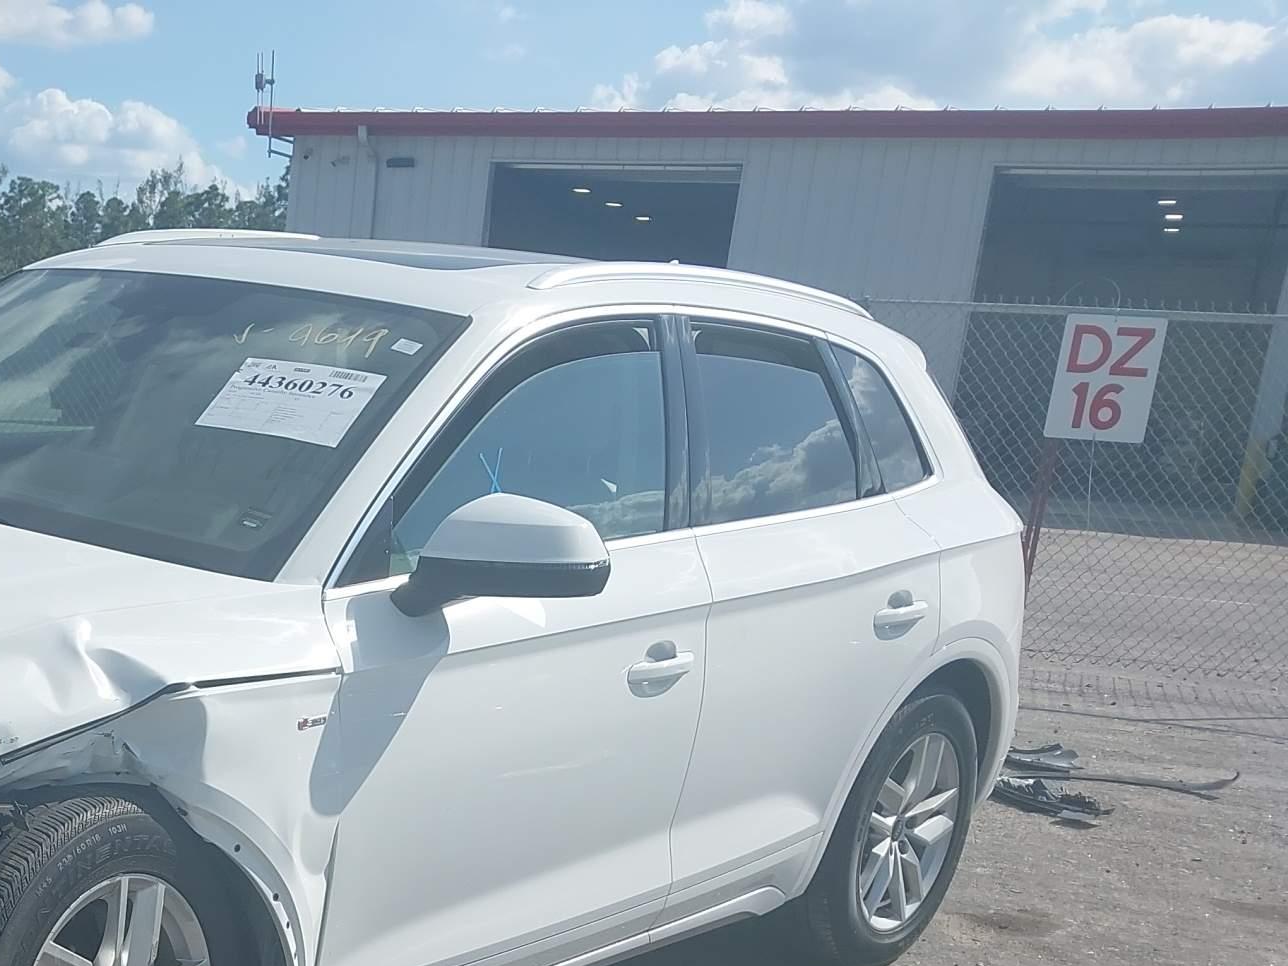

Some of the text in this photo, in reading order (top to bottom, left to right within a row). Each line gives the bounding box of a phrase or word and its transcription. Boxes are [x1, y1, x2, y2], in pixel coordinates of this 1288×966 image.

[1066, 324, 1156, 377] DZ
[243, 373, 358, 400] 44360276
[1071, 382, 1125, 430] 16
